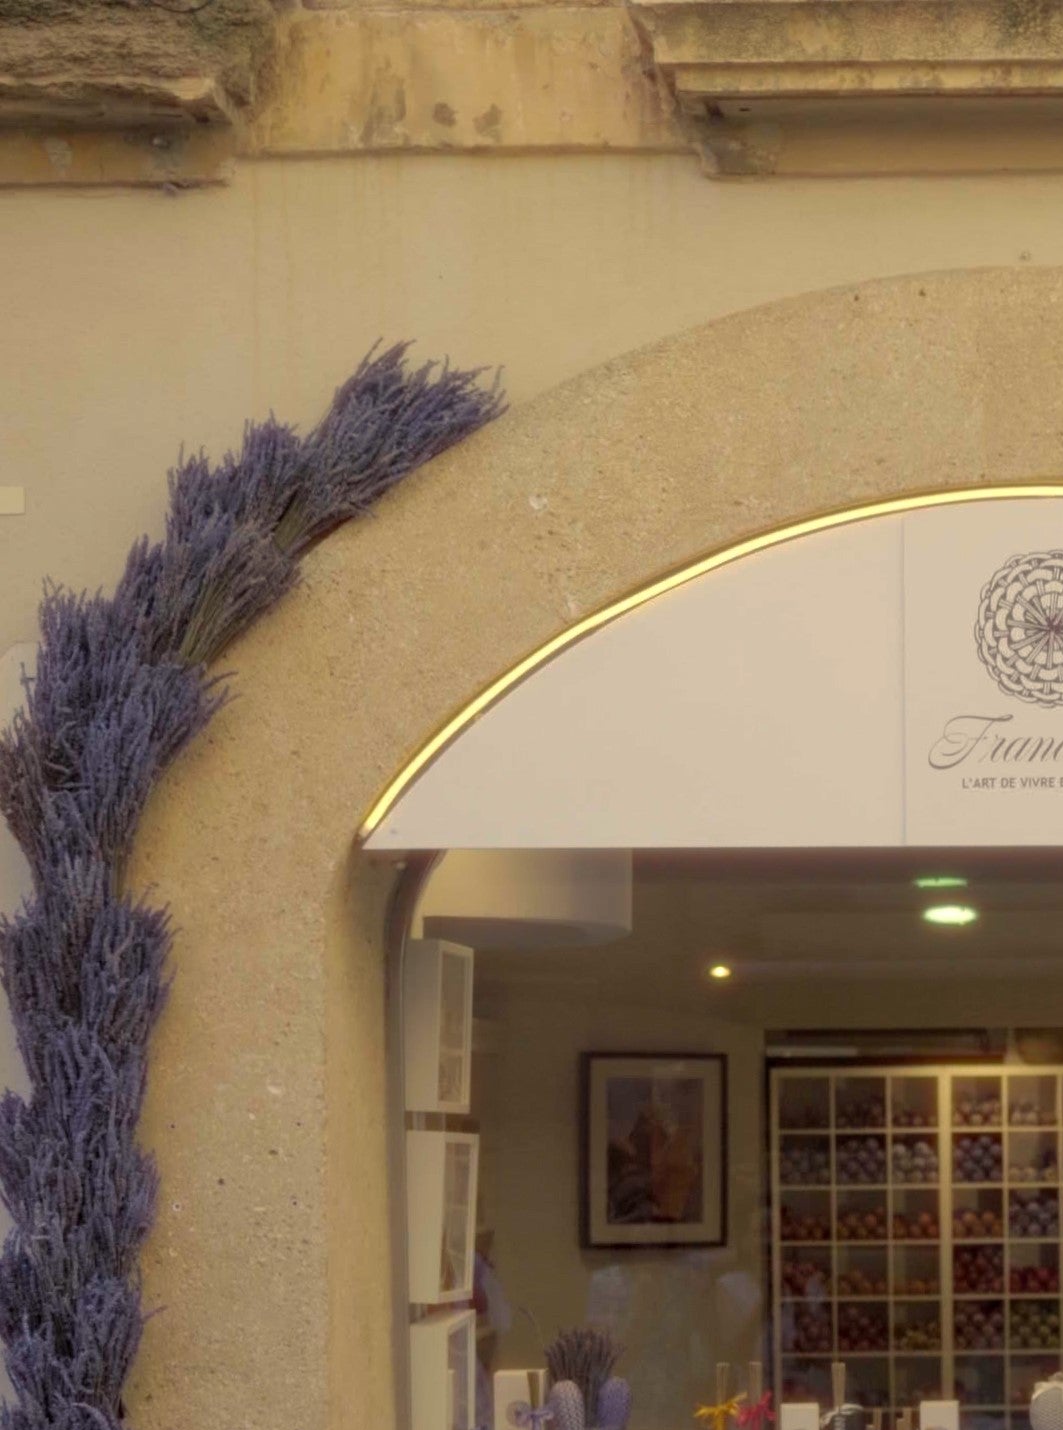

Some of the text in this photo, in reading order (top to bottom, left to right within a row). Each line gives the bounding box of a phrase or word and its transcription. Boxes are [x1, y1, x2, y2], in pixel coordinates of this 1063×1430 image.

[962, 777, 996, 789] L'ART
[1001, 777, 1016, 788] DE
[1020, 776, 1055, 788] VIVRE
